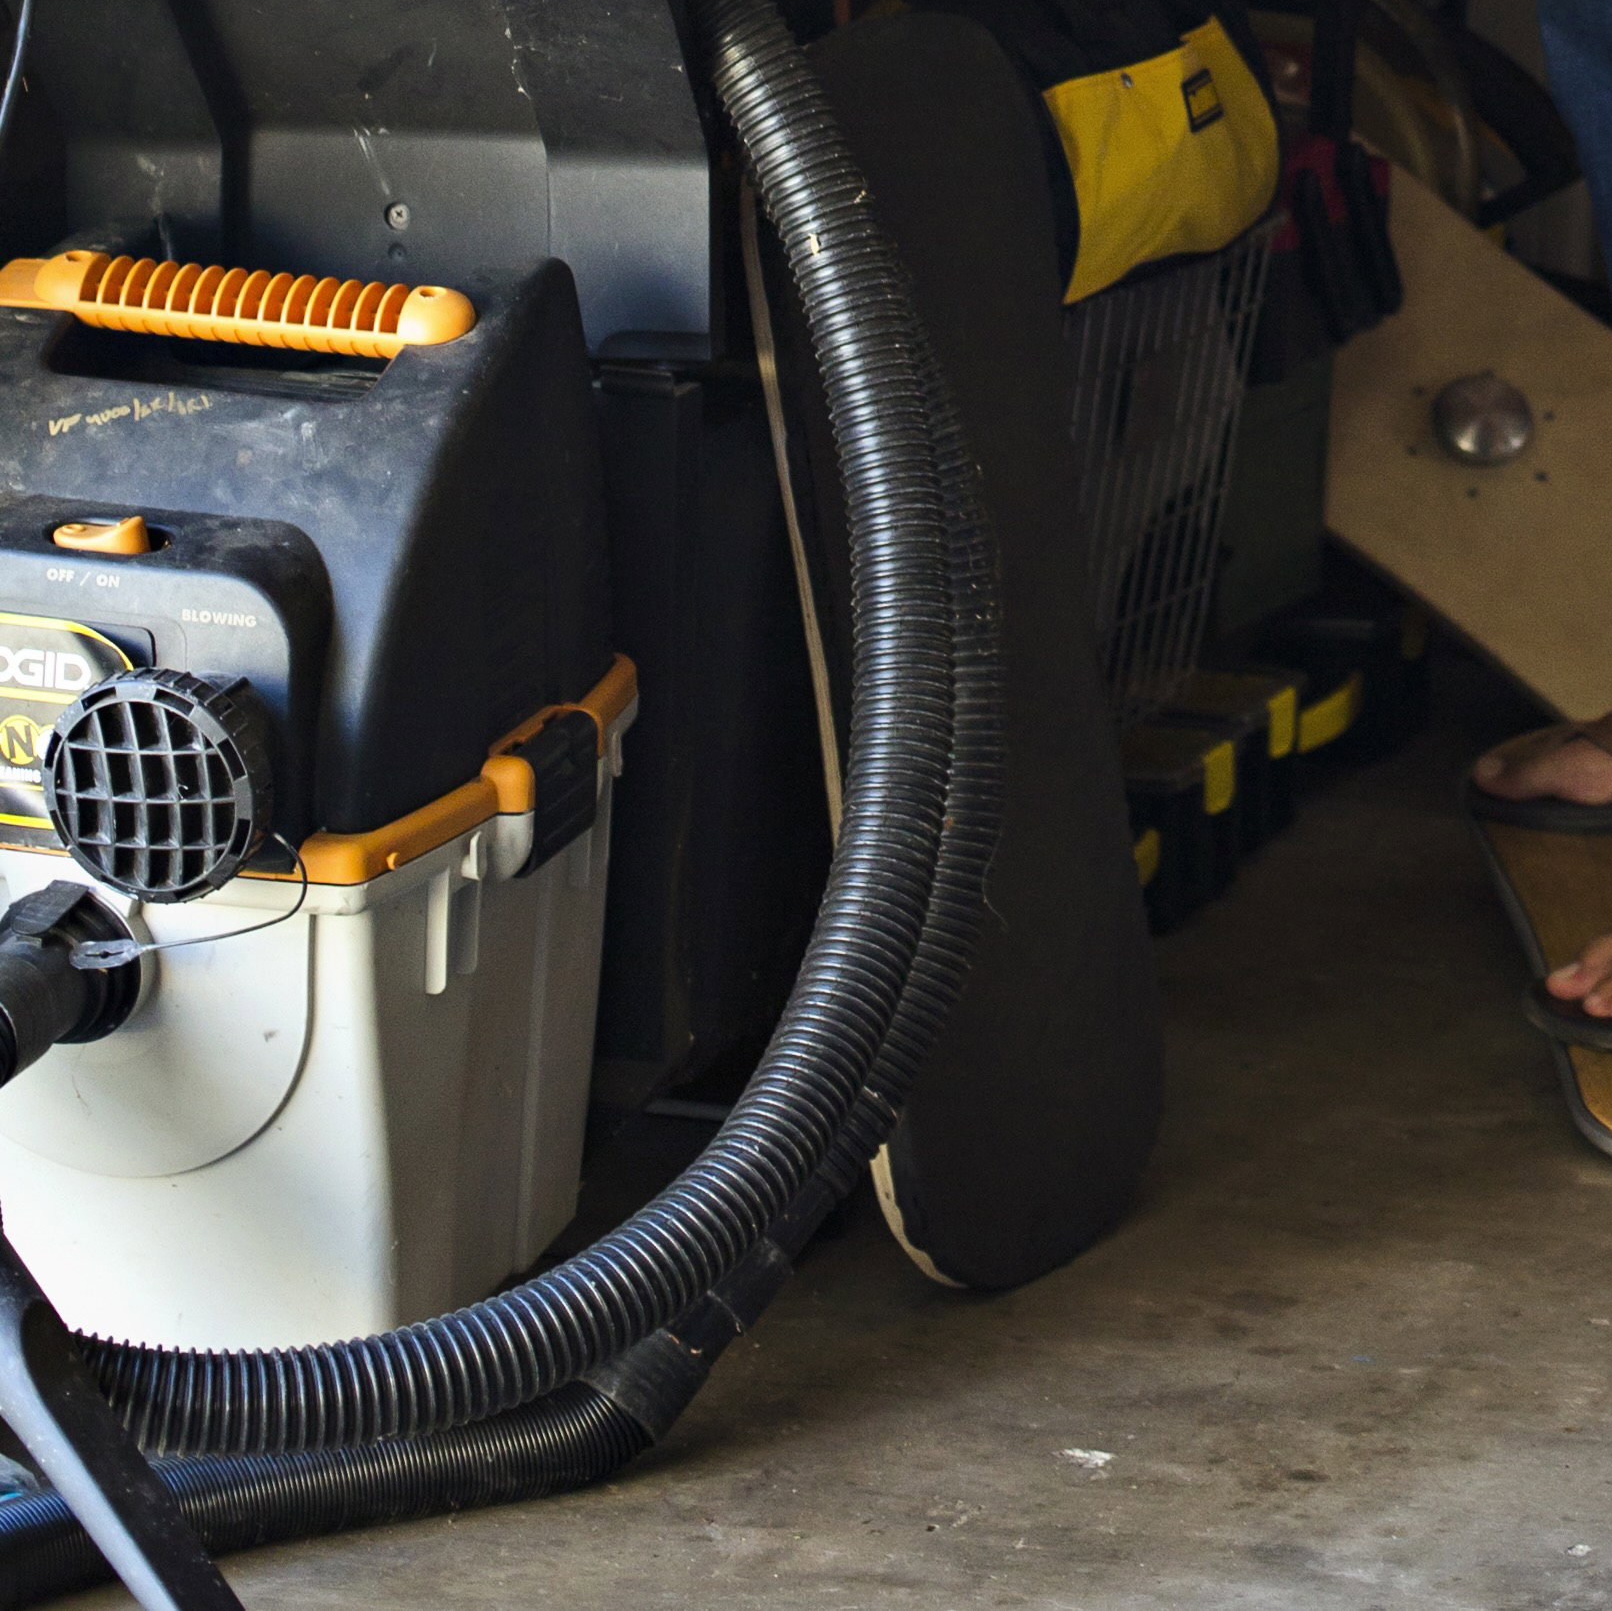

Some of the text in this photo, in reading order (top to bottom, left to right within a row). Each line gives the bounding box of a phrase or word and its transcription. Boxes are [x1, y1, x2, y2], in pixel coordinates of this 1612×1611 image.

[47, 568, 74, 583] OFF
[97, 574, 120, 588] ON
[182, 608, 257, 628] BLOWING
